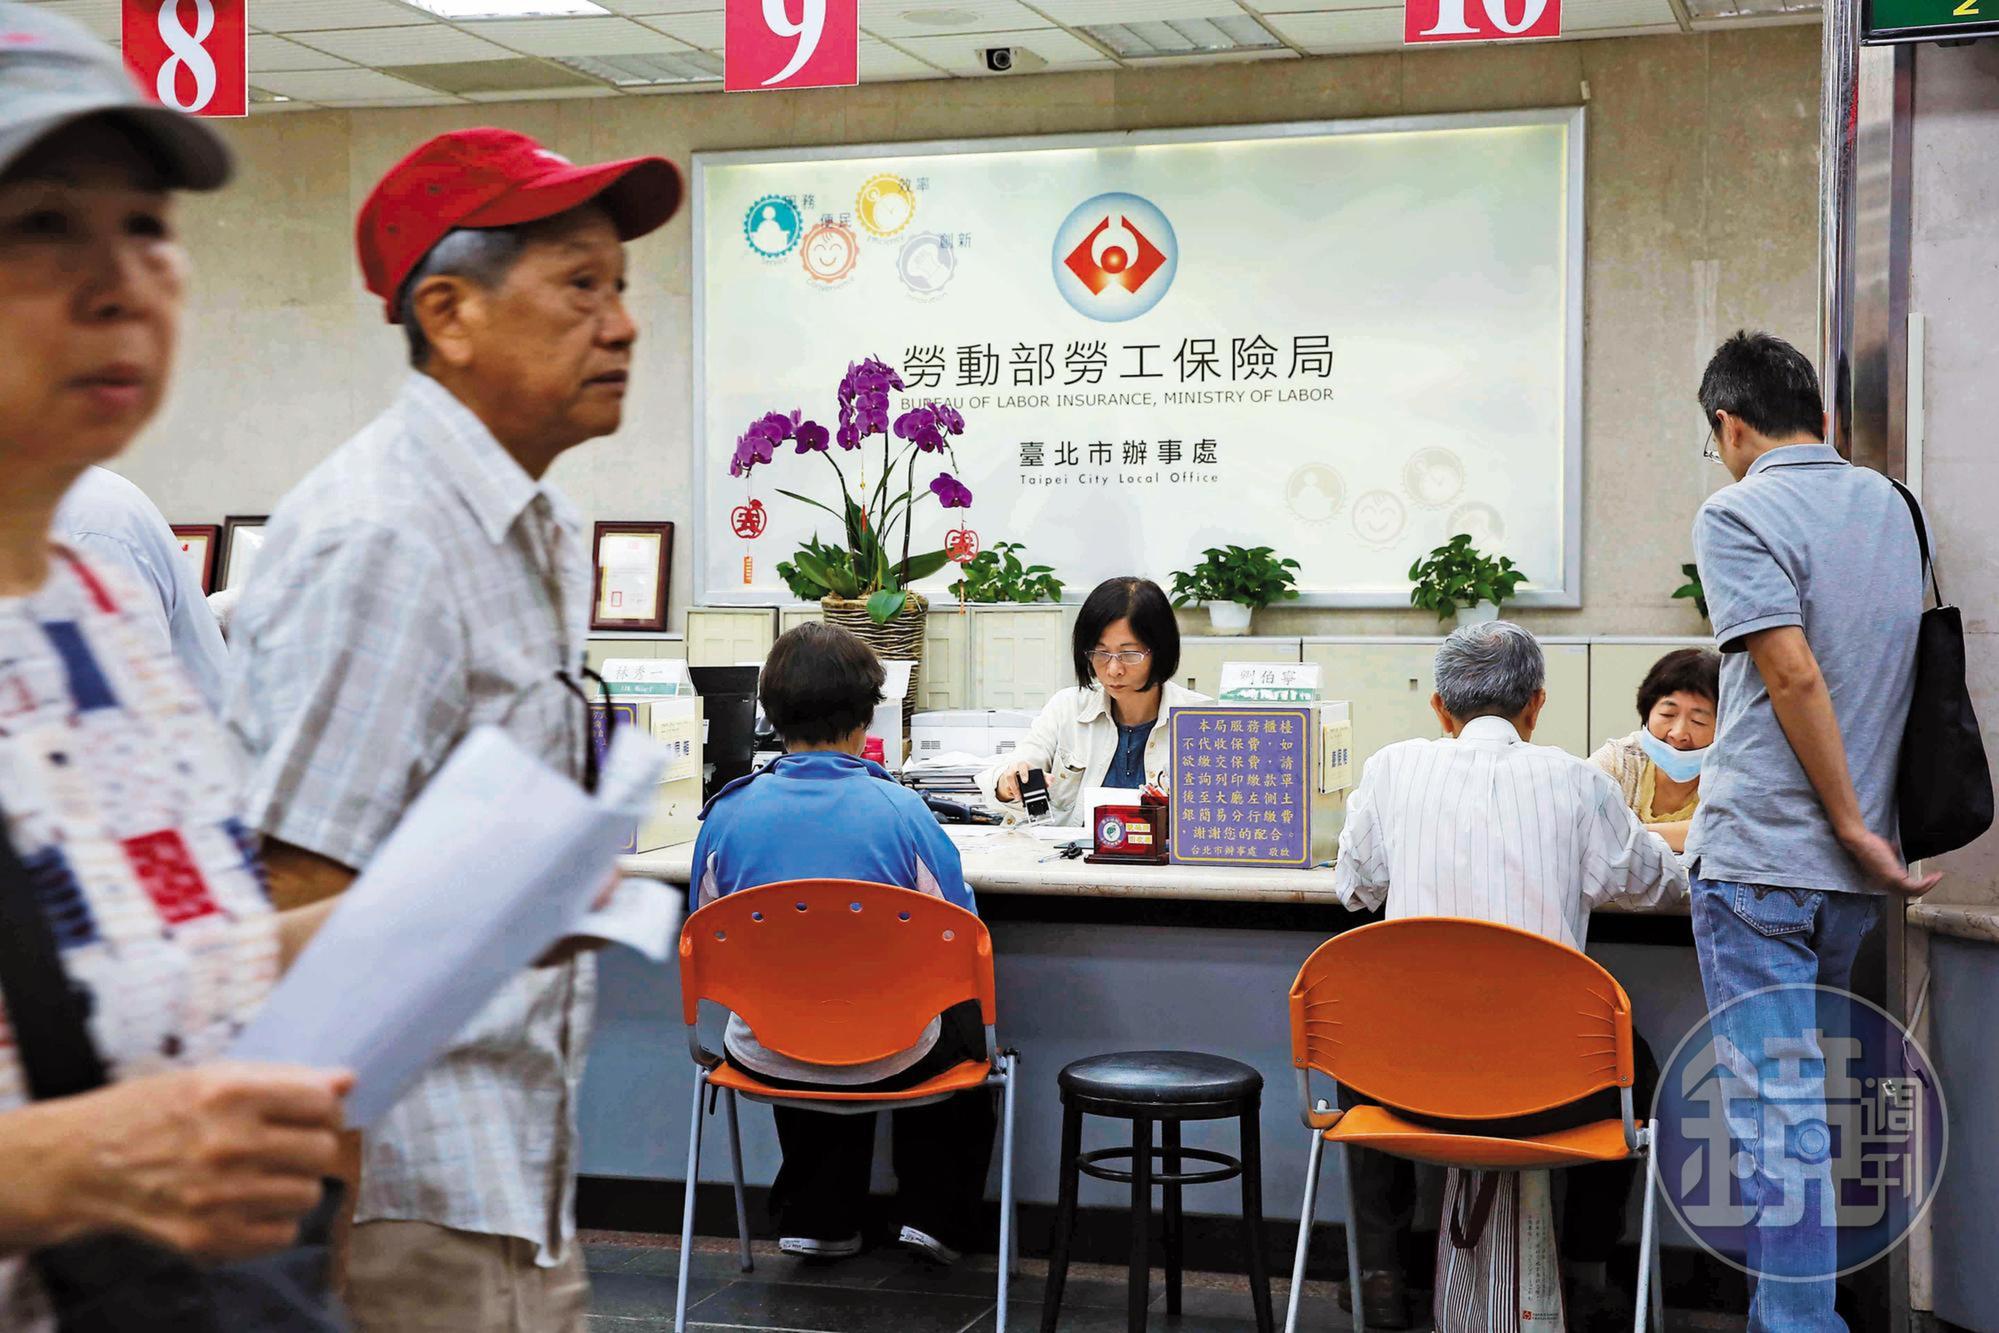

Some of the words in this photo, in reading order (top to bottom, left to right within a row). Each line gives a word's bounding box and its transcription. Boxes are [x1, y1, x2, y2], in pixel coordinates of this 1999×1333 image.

[157, 0, 216, 112] 8
[761, 0, 826, 85] 9
[903, 334, 1333, 388] 勞動部勞工保險局
[969, 396, 990, 409] OF
[997, 395, 1049, 408] LABOR
[1057, 392, 1157, 407] INSURANCE,
[1164, 391, 1245, 404] MINISTRY
[1250, 390, 1272, 403] OF
[1278, 388, 1334, 402] LABOR
[1020, 438, 1217, 467] 臺北市辦事處
[1020, 474, 1069, 487] Taipei
[1078, 474, 1109, 486] City
[1119, 472, 1159, 484] Local
[1170, 472, 1218, 483] Office
[1183, 790, 1293, 805] 後至大廳左側土
